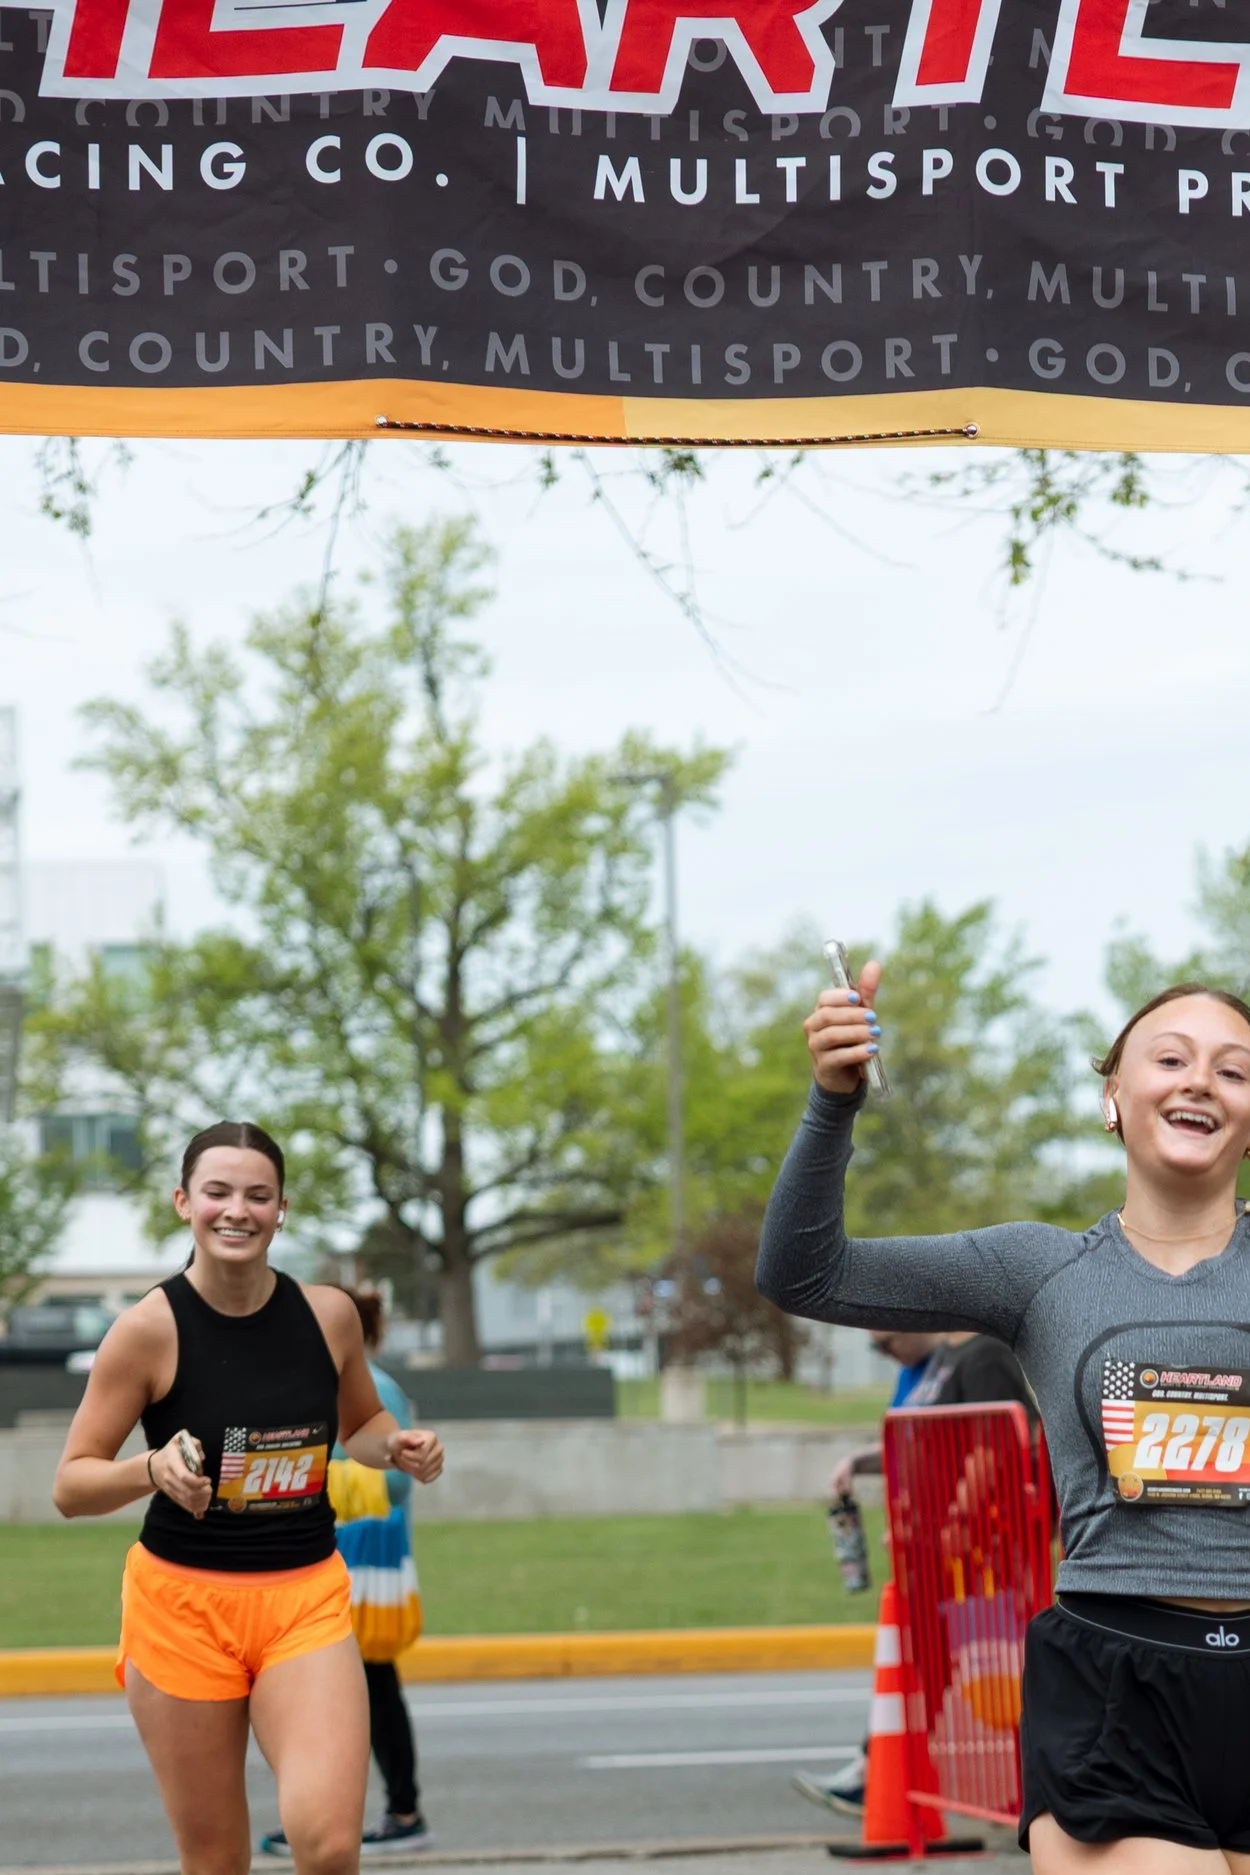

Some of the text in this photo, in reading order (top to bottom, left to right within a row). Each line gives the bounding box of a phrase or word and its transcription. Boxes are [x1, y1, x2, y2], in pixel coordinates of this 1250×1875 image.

[0, 140, 247, 192] CING
[304, 132, 449, 188] CO.
[592, 147, 1125, 209] MULTISPORT
[0, 245, 355, 296] TISPORT
[429, 248, 598, 307] GOD,
[635, 254, 993, 308] COUNTRY,
[78, 322, 449, 375] COUNTRY,
[484, 332, 958, 387] MULTISPORT
[1028, 338, 1192, 394] GOD,
[243, 1454, 314, 1494] 2142
[1205, 1626, 1240, 1647] alo
